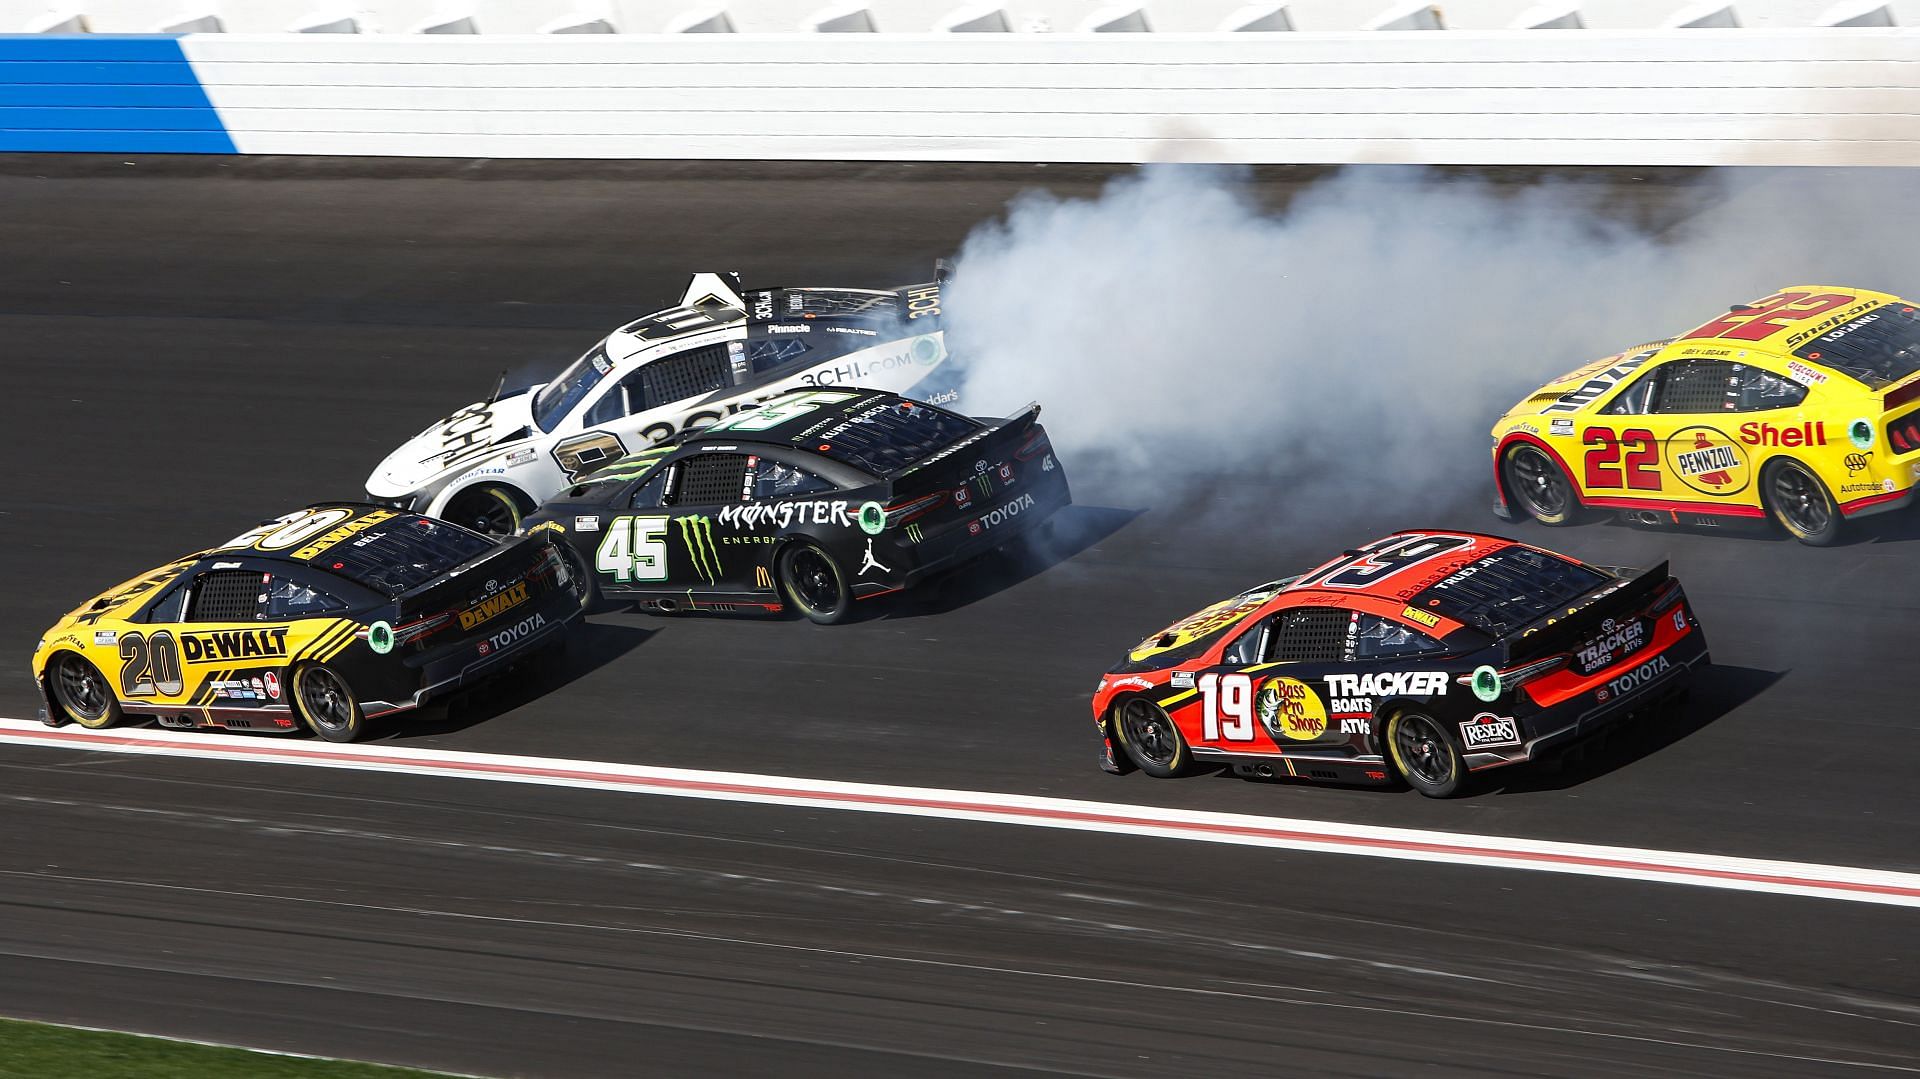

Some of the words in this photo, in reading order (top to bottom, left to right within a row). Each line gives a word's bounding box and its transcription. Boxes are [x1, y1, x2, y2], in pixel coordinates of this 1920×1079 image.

[907, 286, 941, 319] 3CHI
[768, 324, 811, 334] Pinnacle
[1679, 292, 1856, 341] 22
[1786, 300, 1879, 348] Snap-on
[1821, 314, 1880, 342] LOGANO
[800, 353, 912, 387] 3CHI.COM
[1788, 361, 1828, 383] DISCOUNT
[925, 388, 959, 406] ddar's
[820, 422, 852, 440] KURT
[849, 404, 891, 424] BUSCH
[1739, 421, 1826, 447] Shell
[1583, 426, 1662, 491] 22
[1678, 447, 1739, 475] PENNZOIL
[955, 488, 967, 502] QT
[1841, 482, 1883, 494] Autotrader
[980, 493, 1035, 530] TOYOTA
[353, 530, 387, 548] BELL
[596, 515, 670, 583] 45
[722, 536, 777, 545] ENERGY
[1434, 565, 1478, 590] TRUEX
[490, 612, 546, 651] TOYOTA
[1672, 609, 1687, 632] 19
[1577, 621, 1644, 665] TRACKER
[1584, 652, 1613, 673] BOATS
[1624, 637, 1643, 654] ATVs
[118, 629, 184, 697] 20
[1609, 655, 1671, 697] TOYOTA
[1278, 680, 1305, 700] Bass
[1323, 671, 1450, 698] TRACKER
[1198, 673, 1254, 743] 19
[1283, 697, 1305, 716] Pro
[1331, 697, 1372, 713] BOATS
[1288, 714, 1324, 737] Shops
[1340, 718, 1371, 735] ATVs
